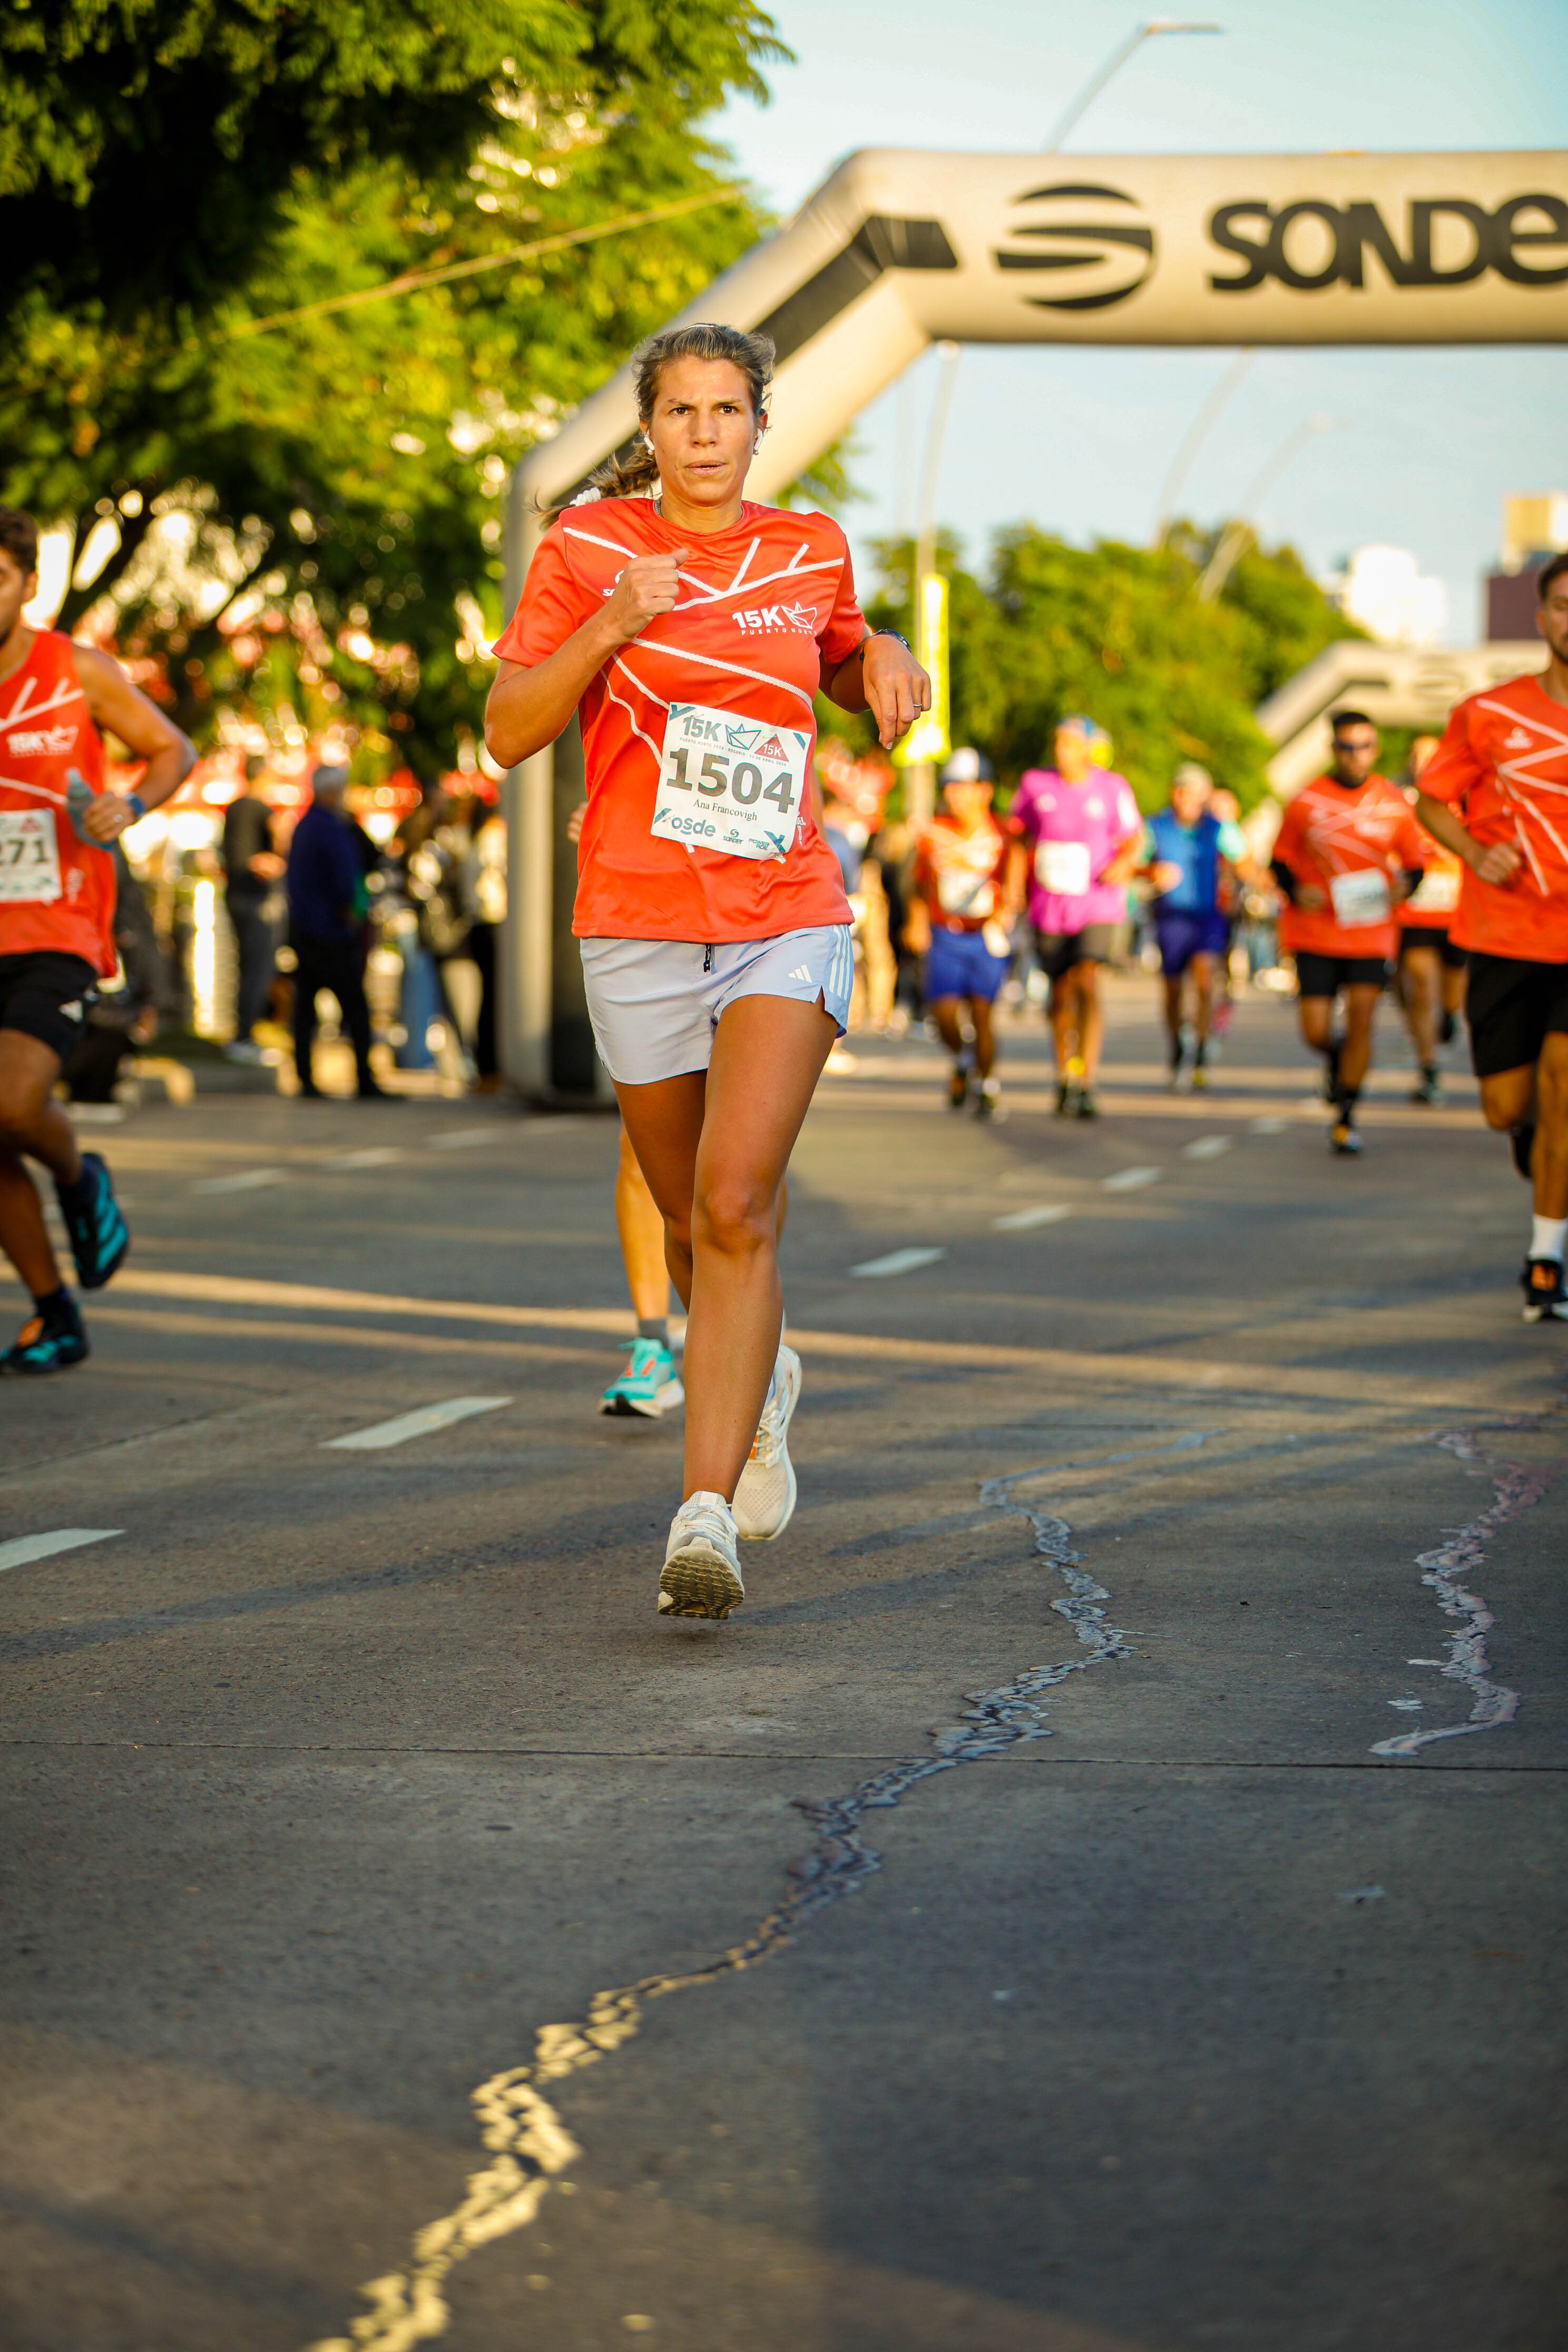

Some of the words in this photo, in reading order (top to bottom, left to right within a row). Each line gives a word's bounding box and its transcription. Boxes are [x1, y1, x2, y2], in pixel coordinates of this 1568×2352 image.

[732, 605, 785, 628] 15K
[683, 717, 722, 741] 15K
[728, 748, 745, 756] ROSARIO
[763, 743, 782, 757] 15K
[666, 747, 795, 814] 1504
[693, 799, 710, 810] Ana
[712, 802, 758, 821] Francovigh
[671, 815, 716, 837] osde
